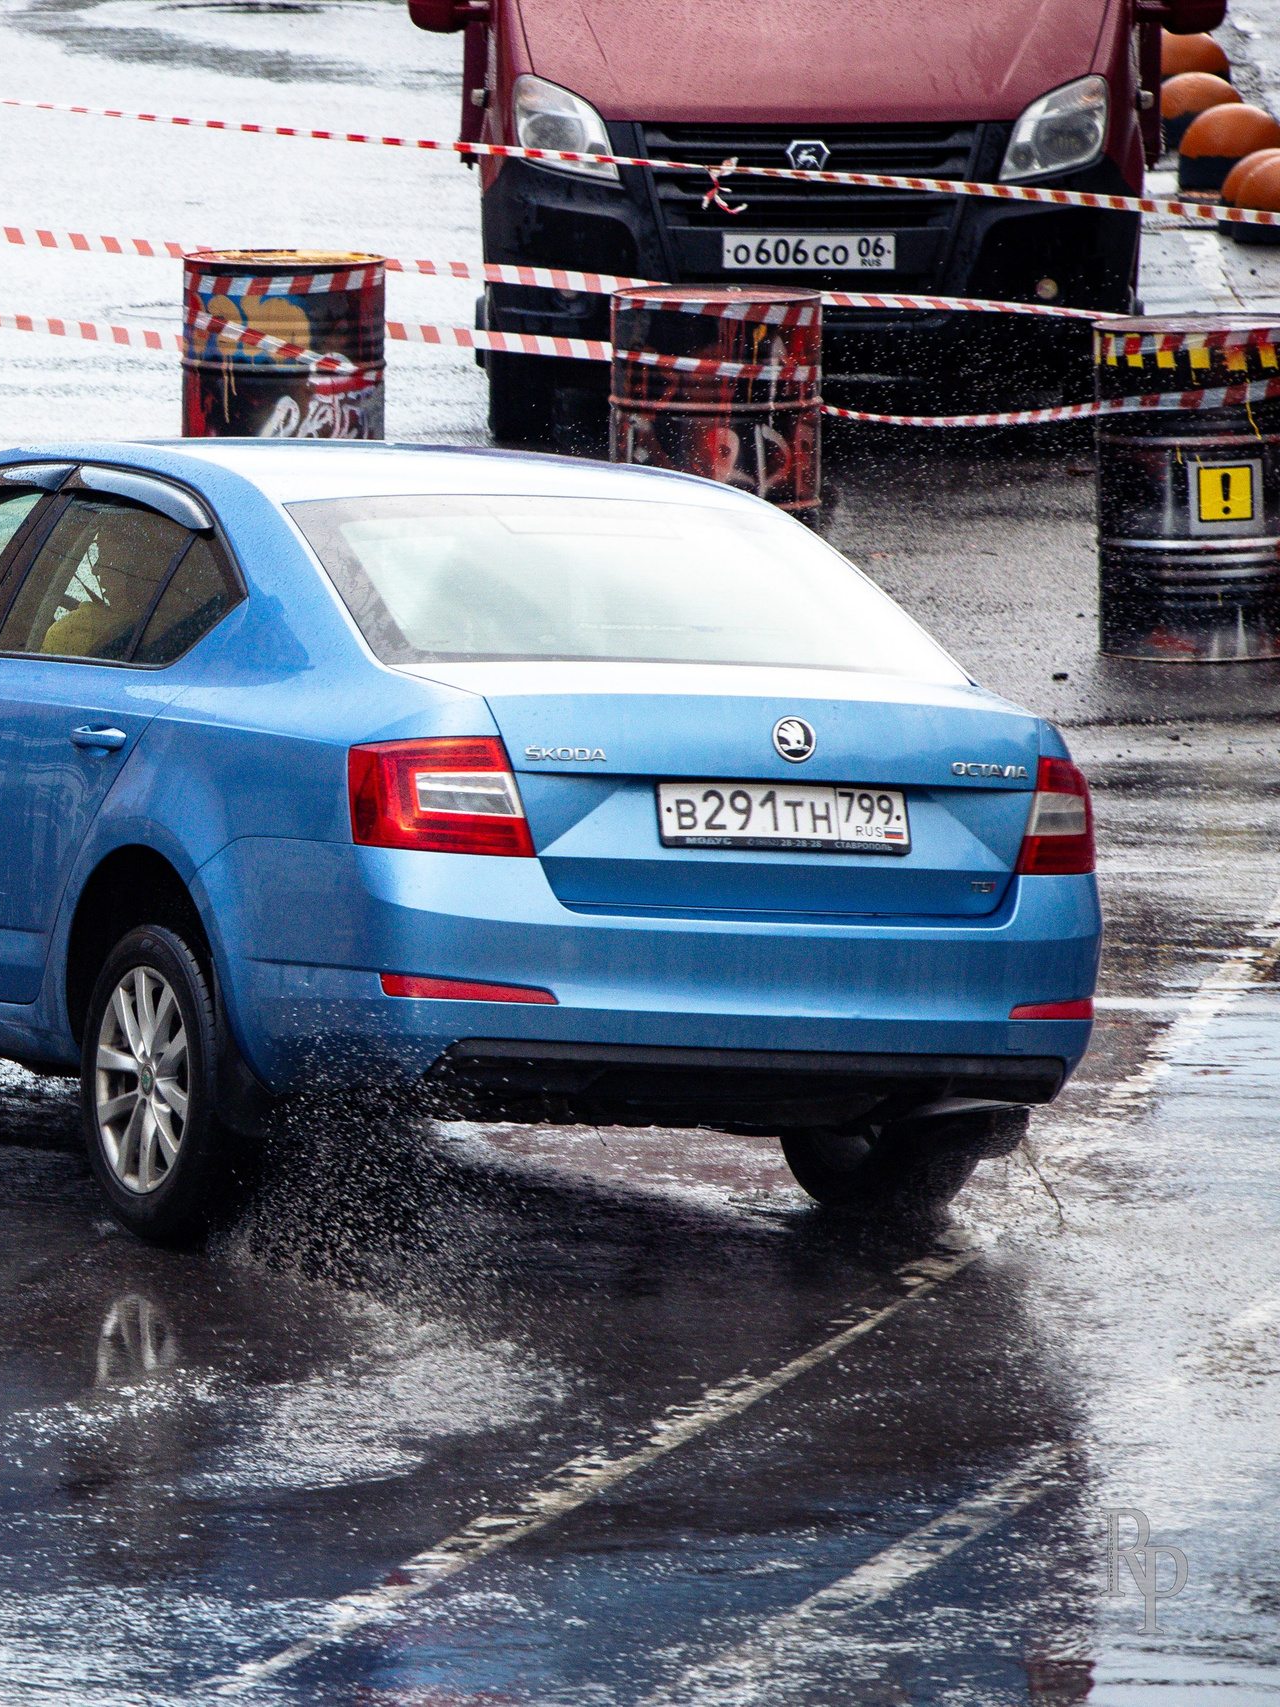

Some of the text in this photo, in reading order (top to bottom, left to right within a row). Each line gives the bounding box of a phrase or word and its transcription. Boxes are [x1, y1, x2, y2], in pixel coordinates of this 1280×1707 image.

[858, 237, 886, 258] 06
[861, 258, 883, 267] RUS
[524, 744, 607, 762] ŠKODA
[951, 762, 1029, 779] OCTAVIA
[838, 791, 895, 826] 799
[855, 826, 884, 838] RUS
[685, 836, 732, 846] МОДУС
[834, 840, 893, 852] СТАВРОПОЛЬ
